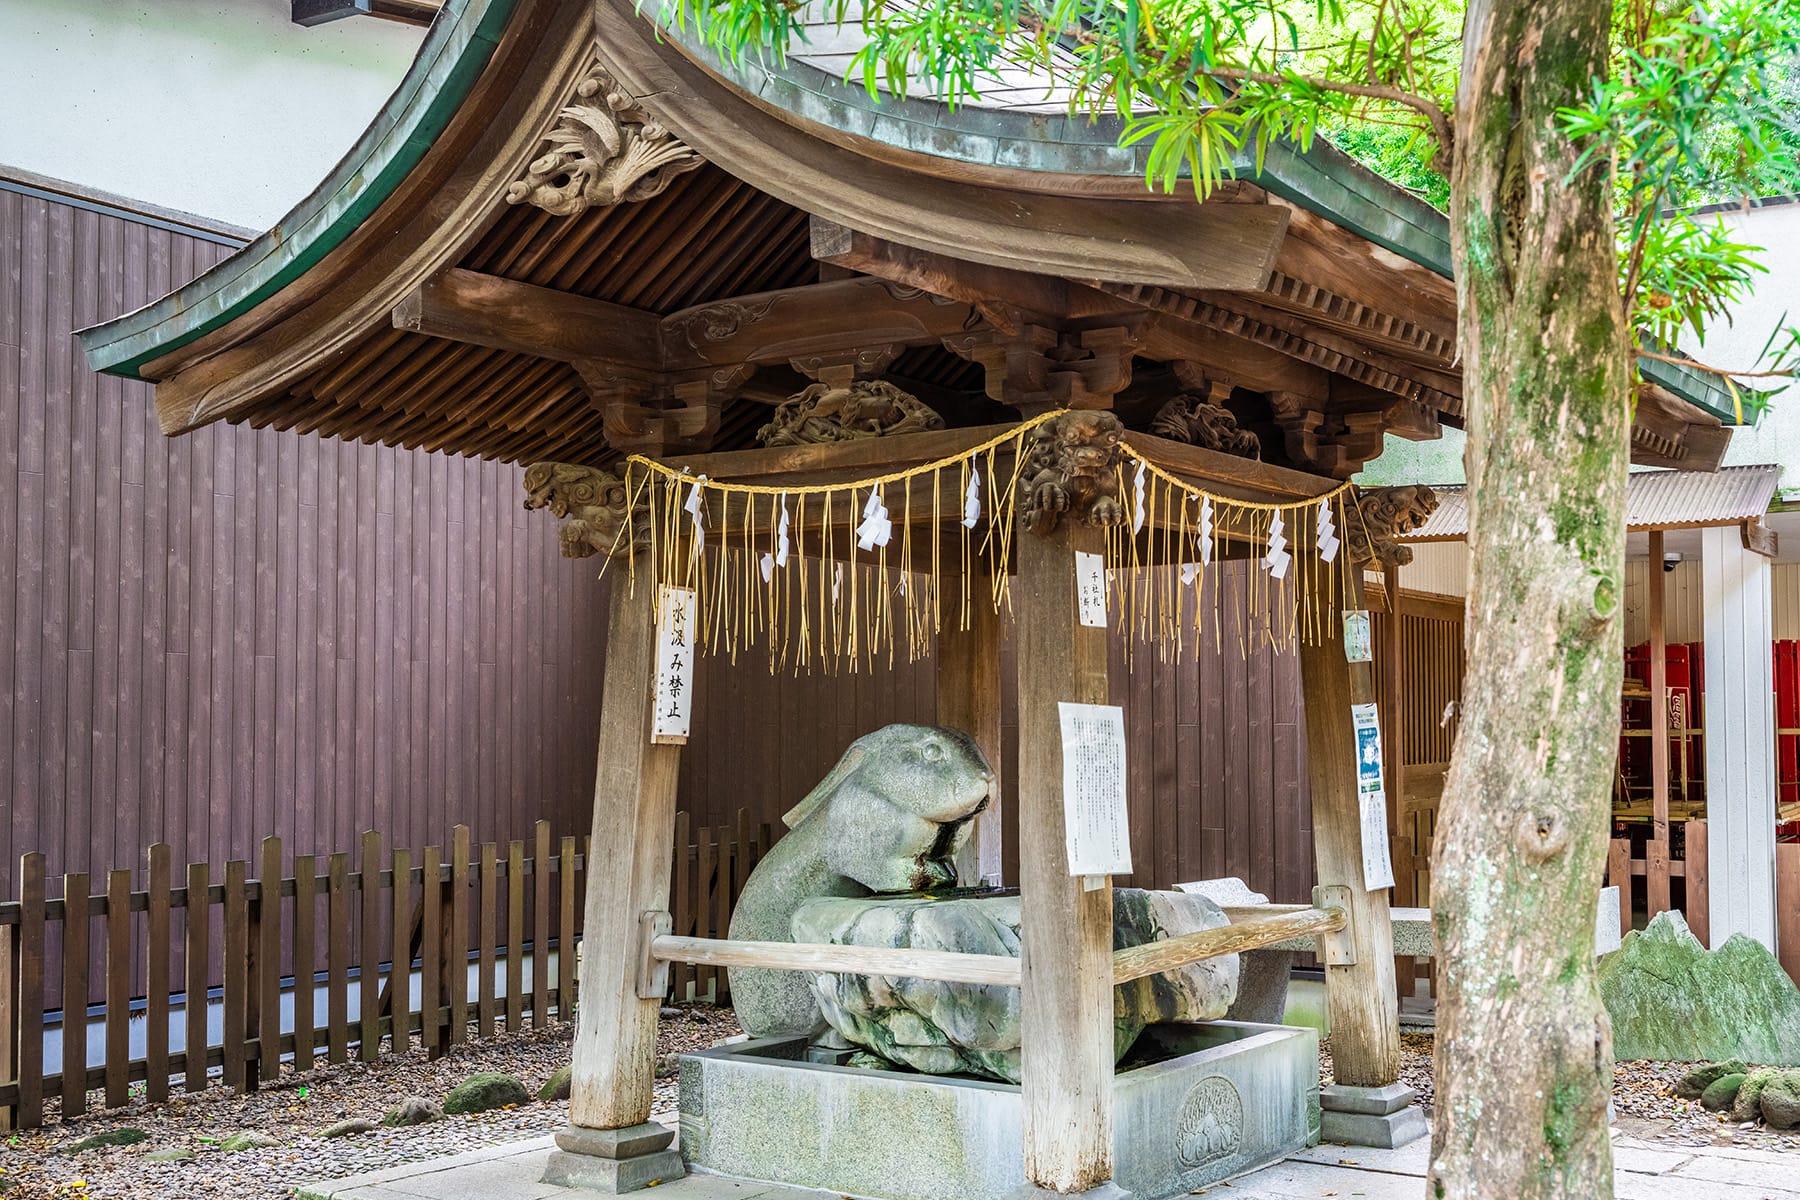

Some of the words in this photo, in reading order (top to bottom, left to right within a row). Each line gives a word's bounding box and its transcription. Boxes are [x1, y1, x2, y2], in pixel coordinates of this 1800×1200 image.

[666, 601, 687, 719] 水汲み禁止
